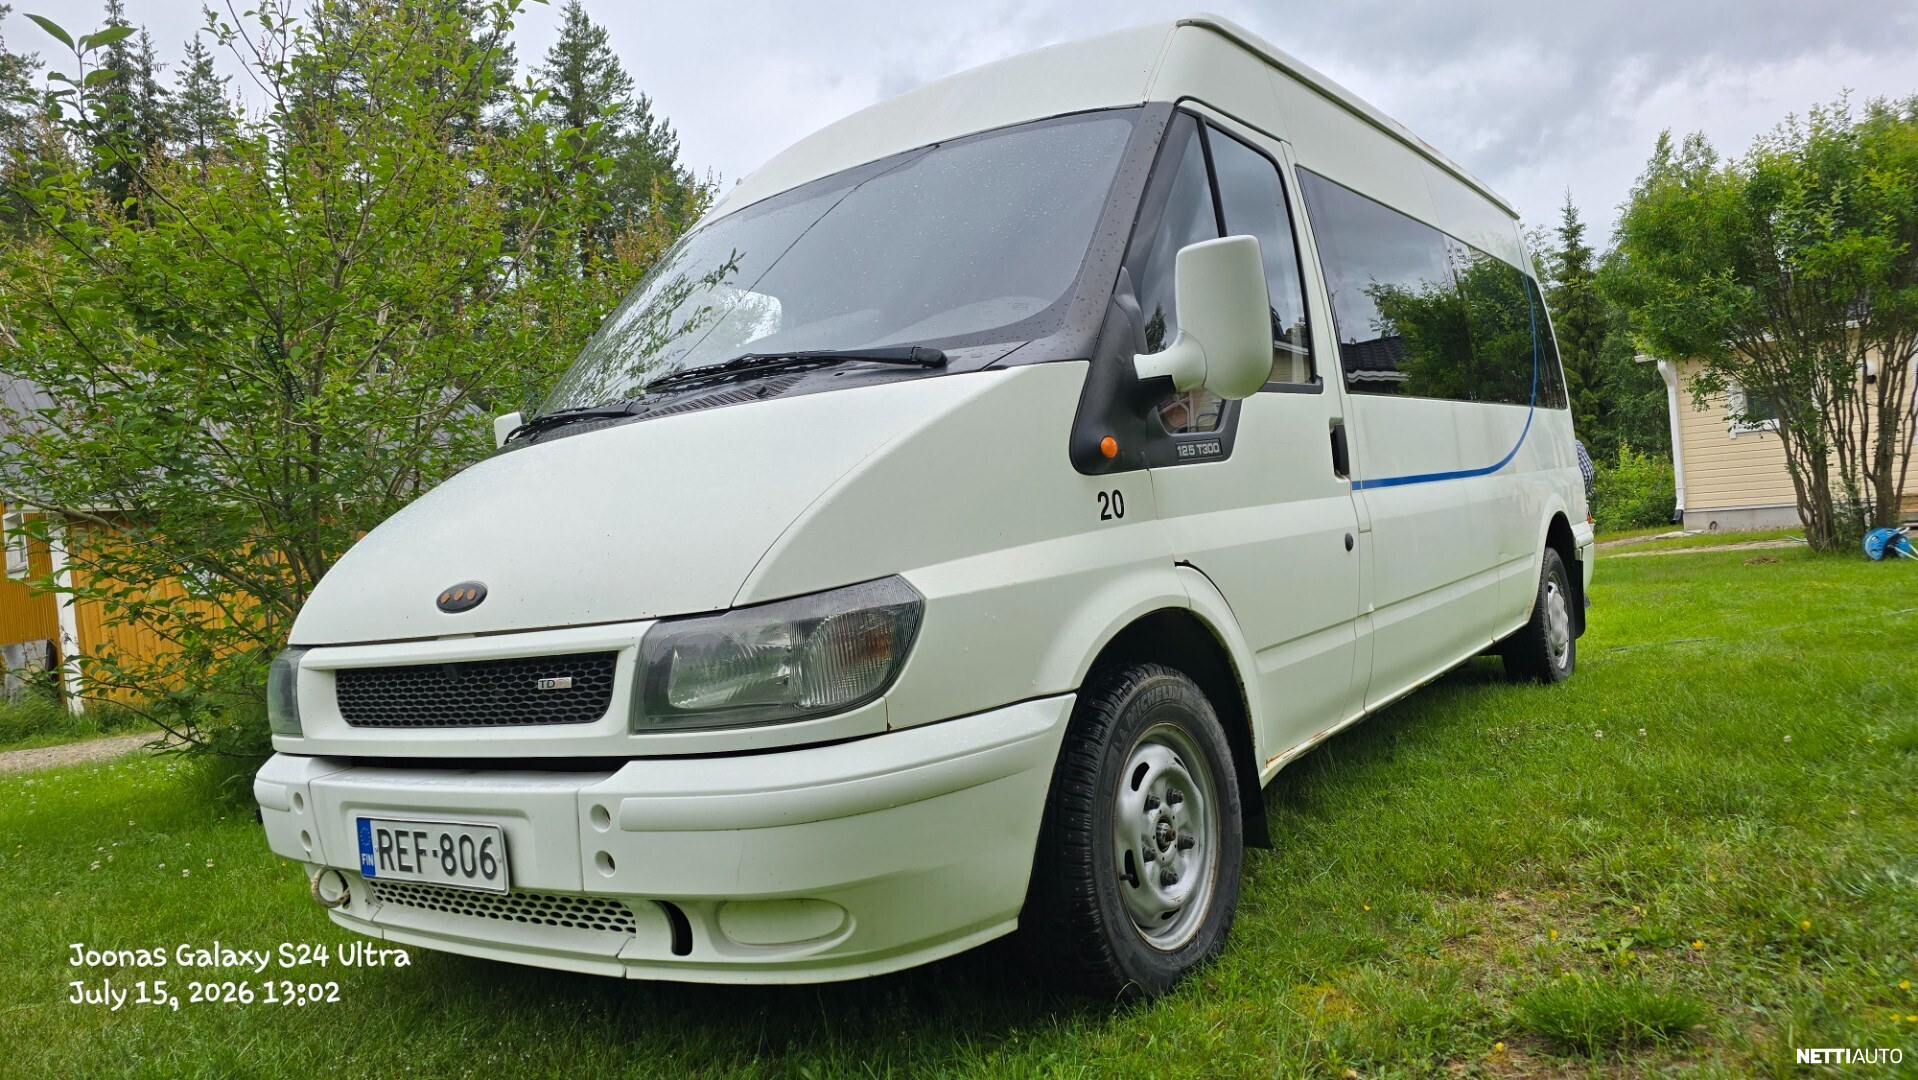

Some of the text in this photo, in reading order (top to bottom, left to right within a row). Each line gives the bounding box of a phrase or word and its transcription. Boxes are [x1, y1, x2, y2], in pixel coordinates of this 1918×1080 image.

[1177, 442, 1220, 457] 125 T300
[1097, 489, 1125, 521] 20
[1126, 685, 1182, 728] MICHELIN
[361, 853, 374, 867] FIN
[376, 828, 498, 881] REF-806
